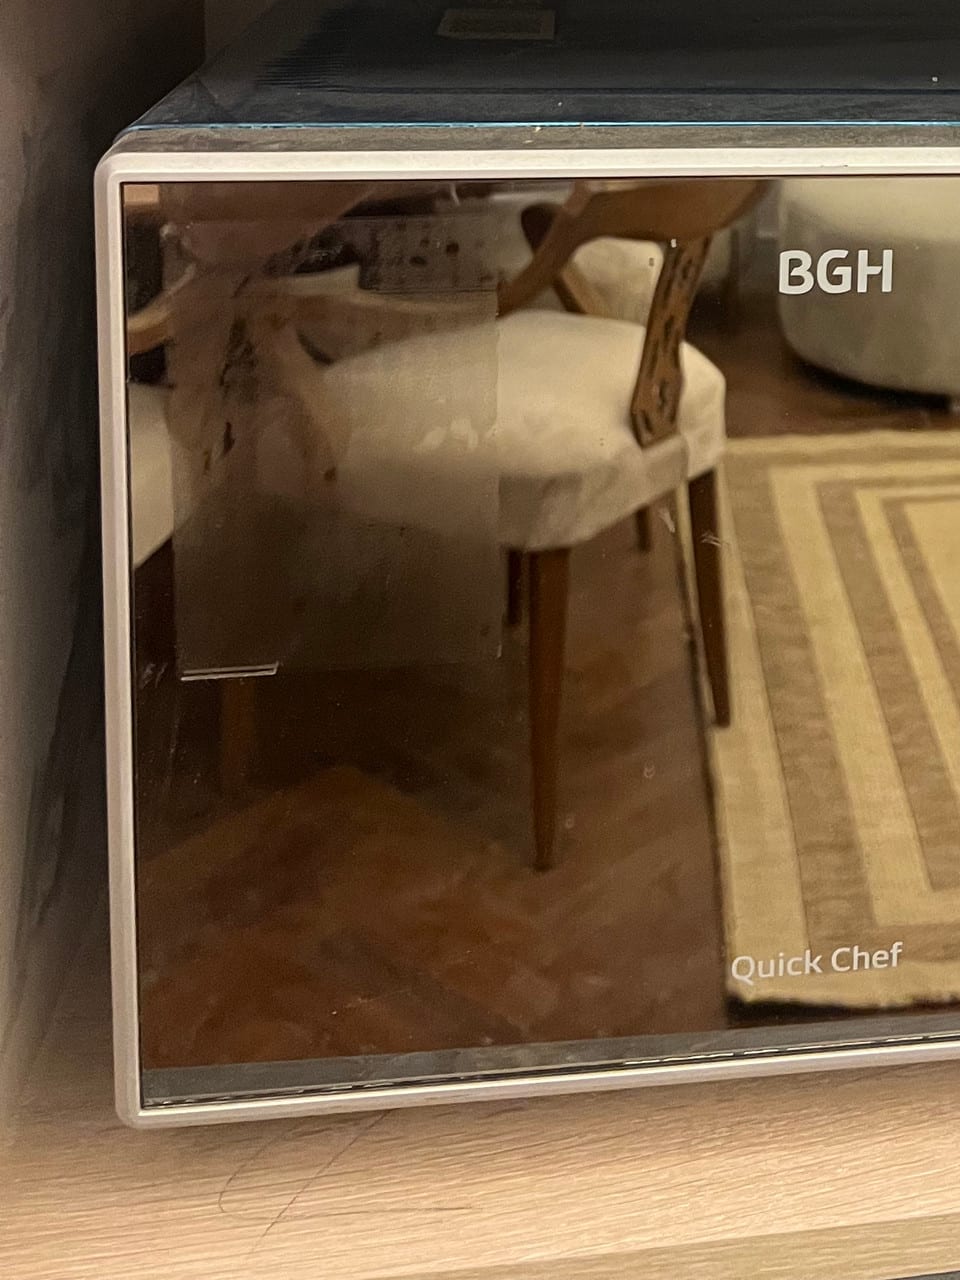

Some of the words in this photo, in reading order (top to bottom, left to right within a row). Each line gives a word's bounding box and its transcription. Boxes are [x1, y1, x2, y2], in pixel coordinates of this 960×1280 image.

[778, 249, 893, 295] BGH
[731, 949, 823, 986] Quick
[831, 941, 903, 972] Chef
